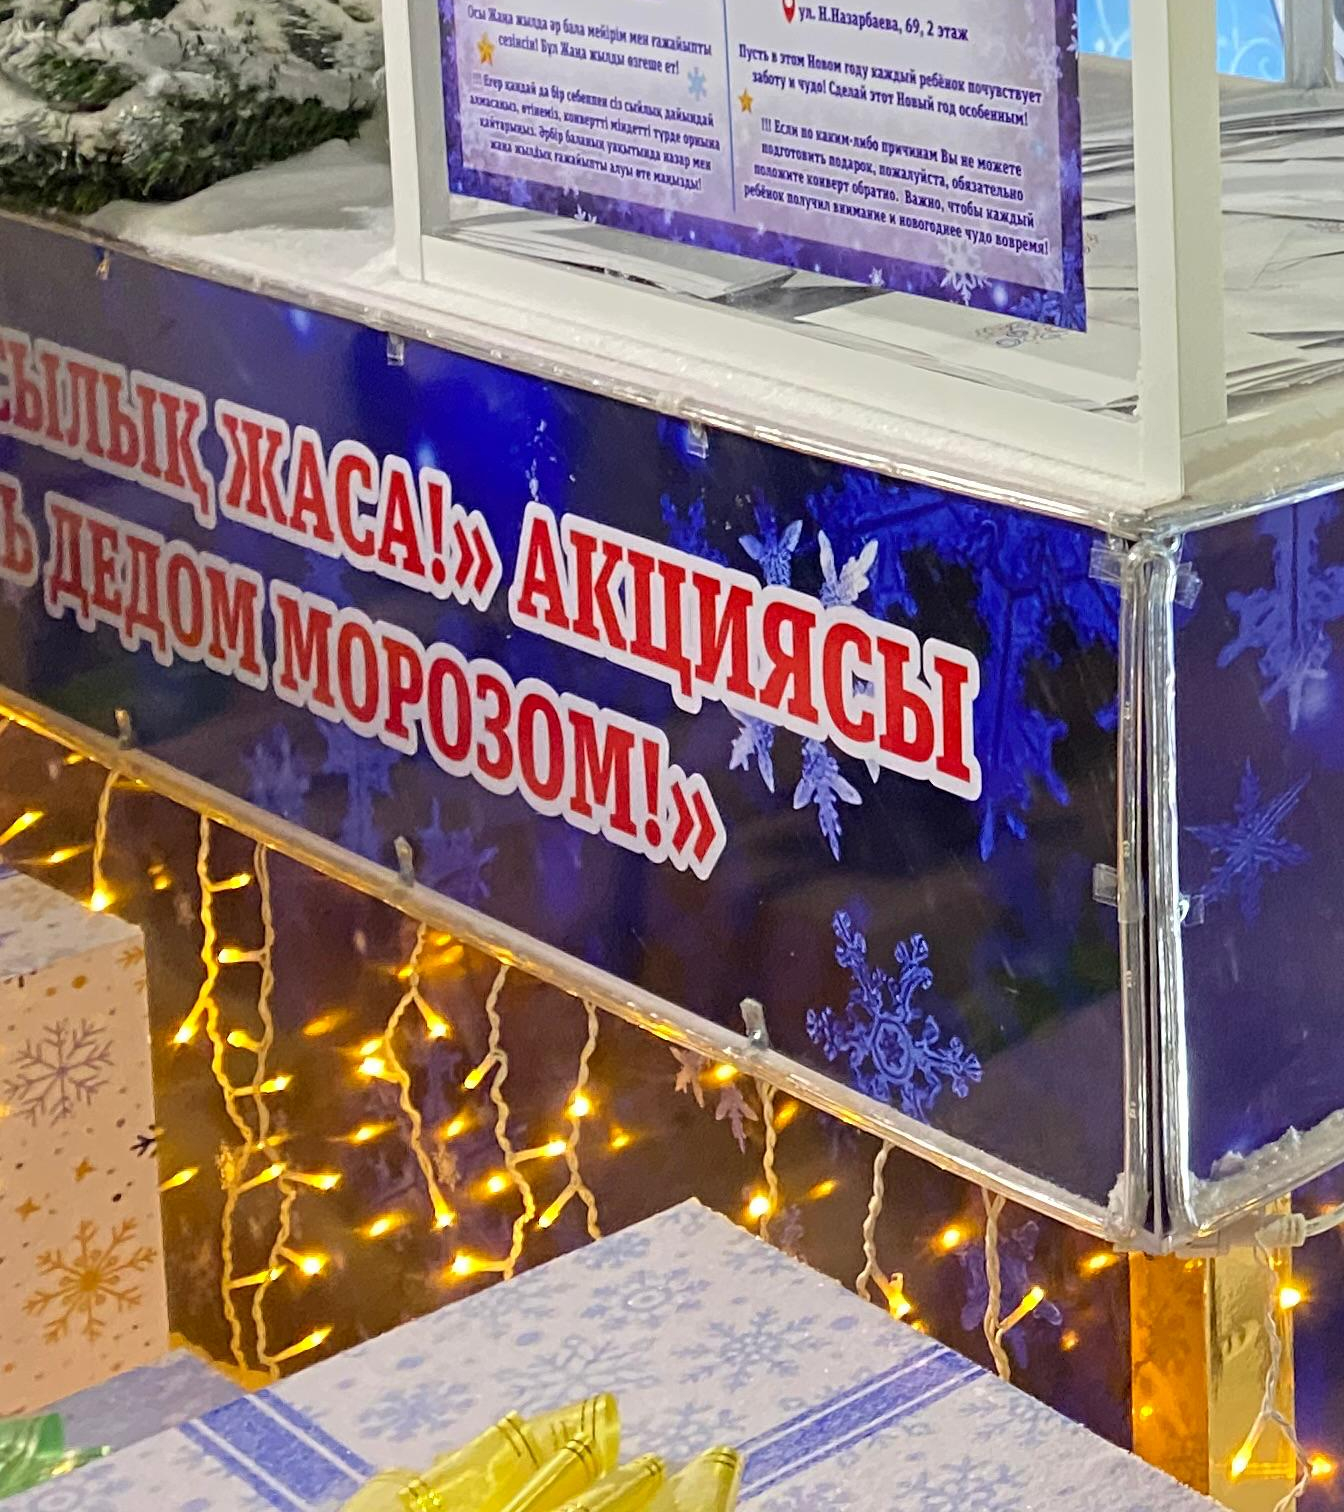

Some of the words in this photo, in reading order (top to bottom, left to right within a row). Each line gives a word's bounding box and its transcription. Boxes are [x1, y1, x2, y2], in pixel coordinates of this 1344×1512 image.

[798, 6, 816, 22] ул.
[936, 24, 968, 41] этаж
[738, 42, 769, 62] Пусть
[779, 51, 804, 67] этом
[806, 52, 842, 73] Новом
[844, 61, 868, 80] году
[871, 65, 916, 84] каждый
[967, 80, 1042, 105] почувствует
[751, 68, 787, 90] заботу
[797, 77, 826, 94] чудо!
[828, 78, 867, 100] Сделай
[869, 88, 894, 104] этот
[896, 89, 934, 111] Новый
[936, 99, 956, 117] год
[958, 102, 1028, 126] особенным!
[761, 141, 826, 165] подготовить
[828, 153, 876, 176] подарок,
[878, 162, 949, 190] пожалуйста,
[951, 173, 1023, 201] обязательно
[773, 118, 798, 137] Если
[800, 126, 813, 140] по
[881, 139, 938, 161] причинам
[940, 146, 957, 165] Вы
[960, 153, 974, 168] не
[976, 156, 1022, 176] можете
[753, 163, 804, 184] положите
[806, 172, 849, 195] конверт
[851, 179, 899, 202] обратно.
[904, 187, 944, 213] Важно,
[947, 199, 983, 218] чтобы
[985, 206, 1034, 227] каждый
[786, 191, 830, 212] получил
[832, 200, 886, 223] внимание
[898, 213, 962, 237] новогоднее
[964, 226, 992, 245] чудо
[994, 232, 1048, 254] вовремя!
[0, 339, 210, 516] ЫЛЫҚ
[221, 412, 496, 596] ЖАСА!»
[514, 515, 974, 785] АКЦИЯСЫ
[49, 501, 262, 678] ДЕДОМ
[275, 594, 719, 864] МОРОЗОМ!»
